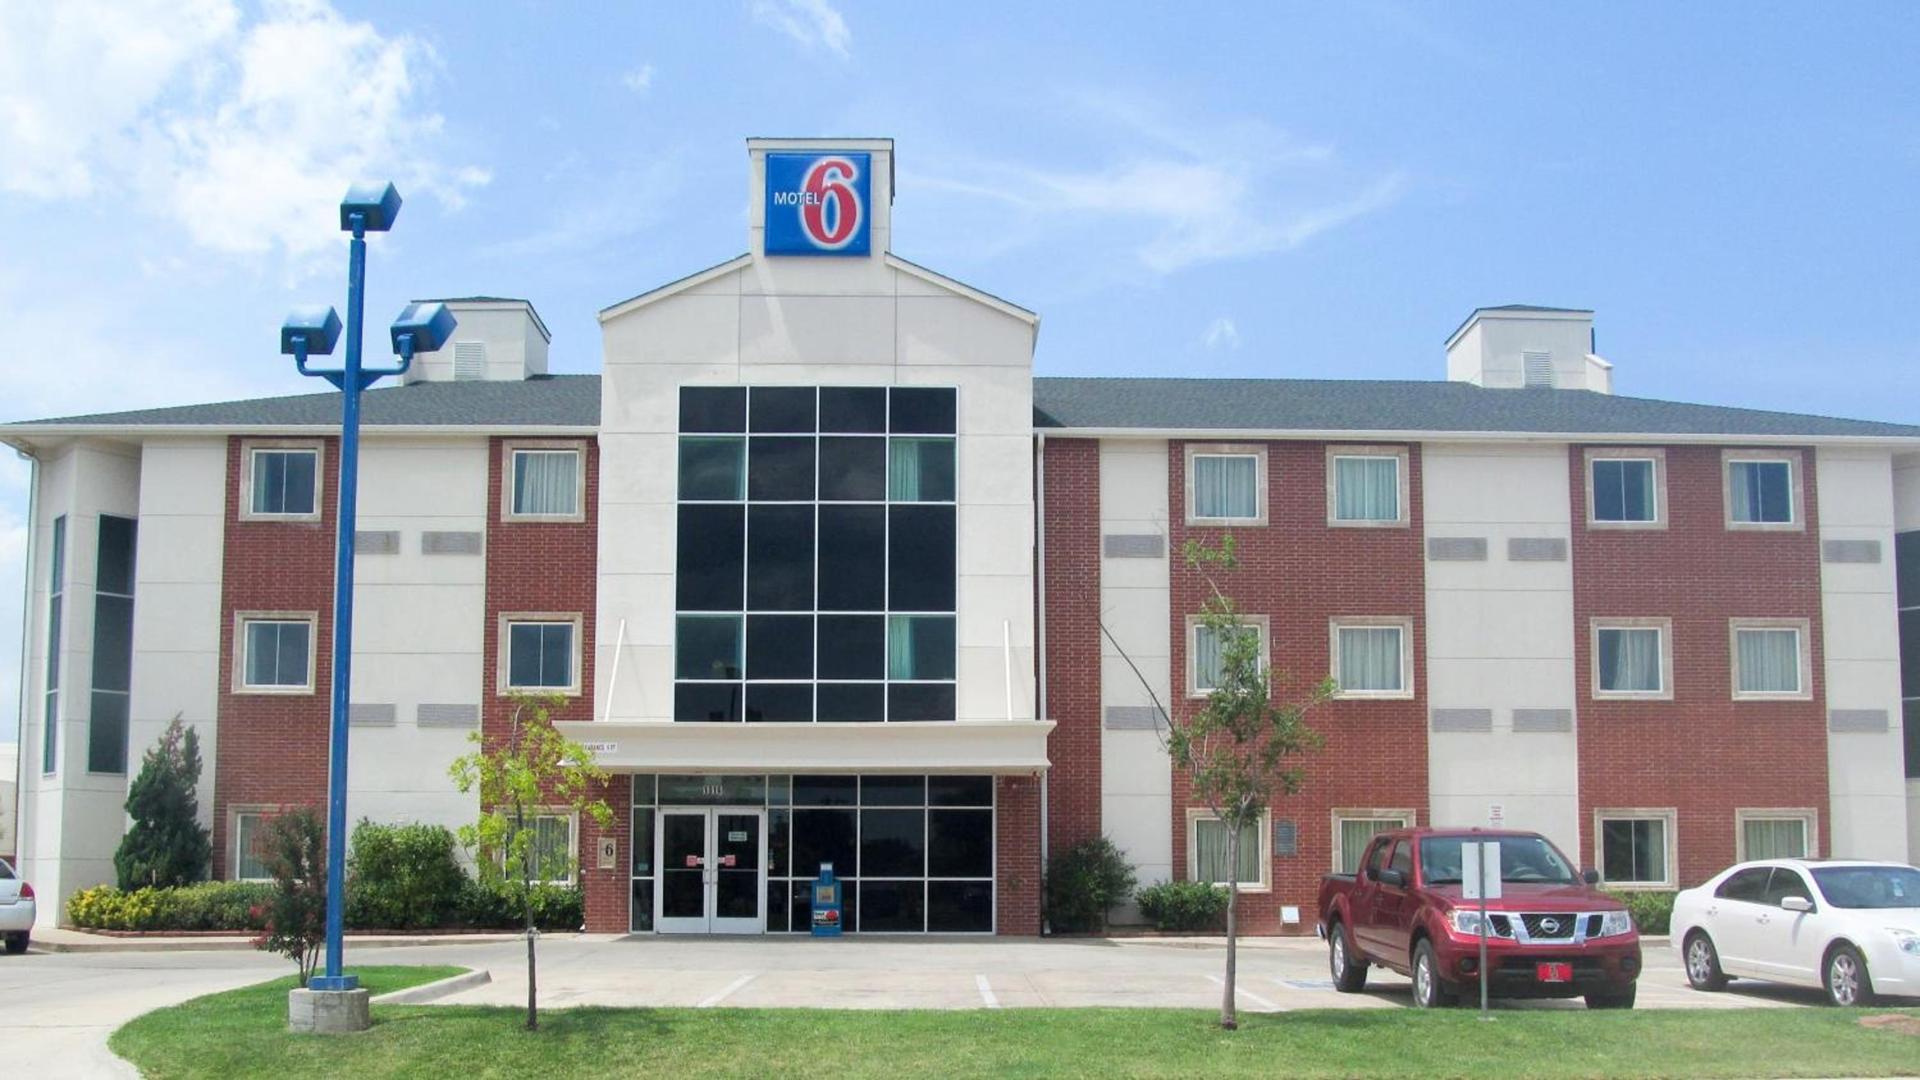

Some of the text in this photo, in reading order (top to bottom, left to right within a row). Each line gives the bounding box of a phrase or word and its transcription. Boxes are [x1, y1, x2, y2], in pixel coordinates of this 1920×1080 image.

[774, 156, 862, 249] MOTEL 6
[605, 843, 614, 857] 6
